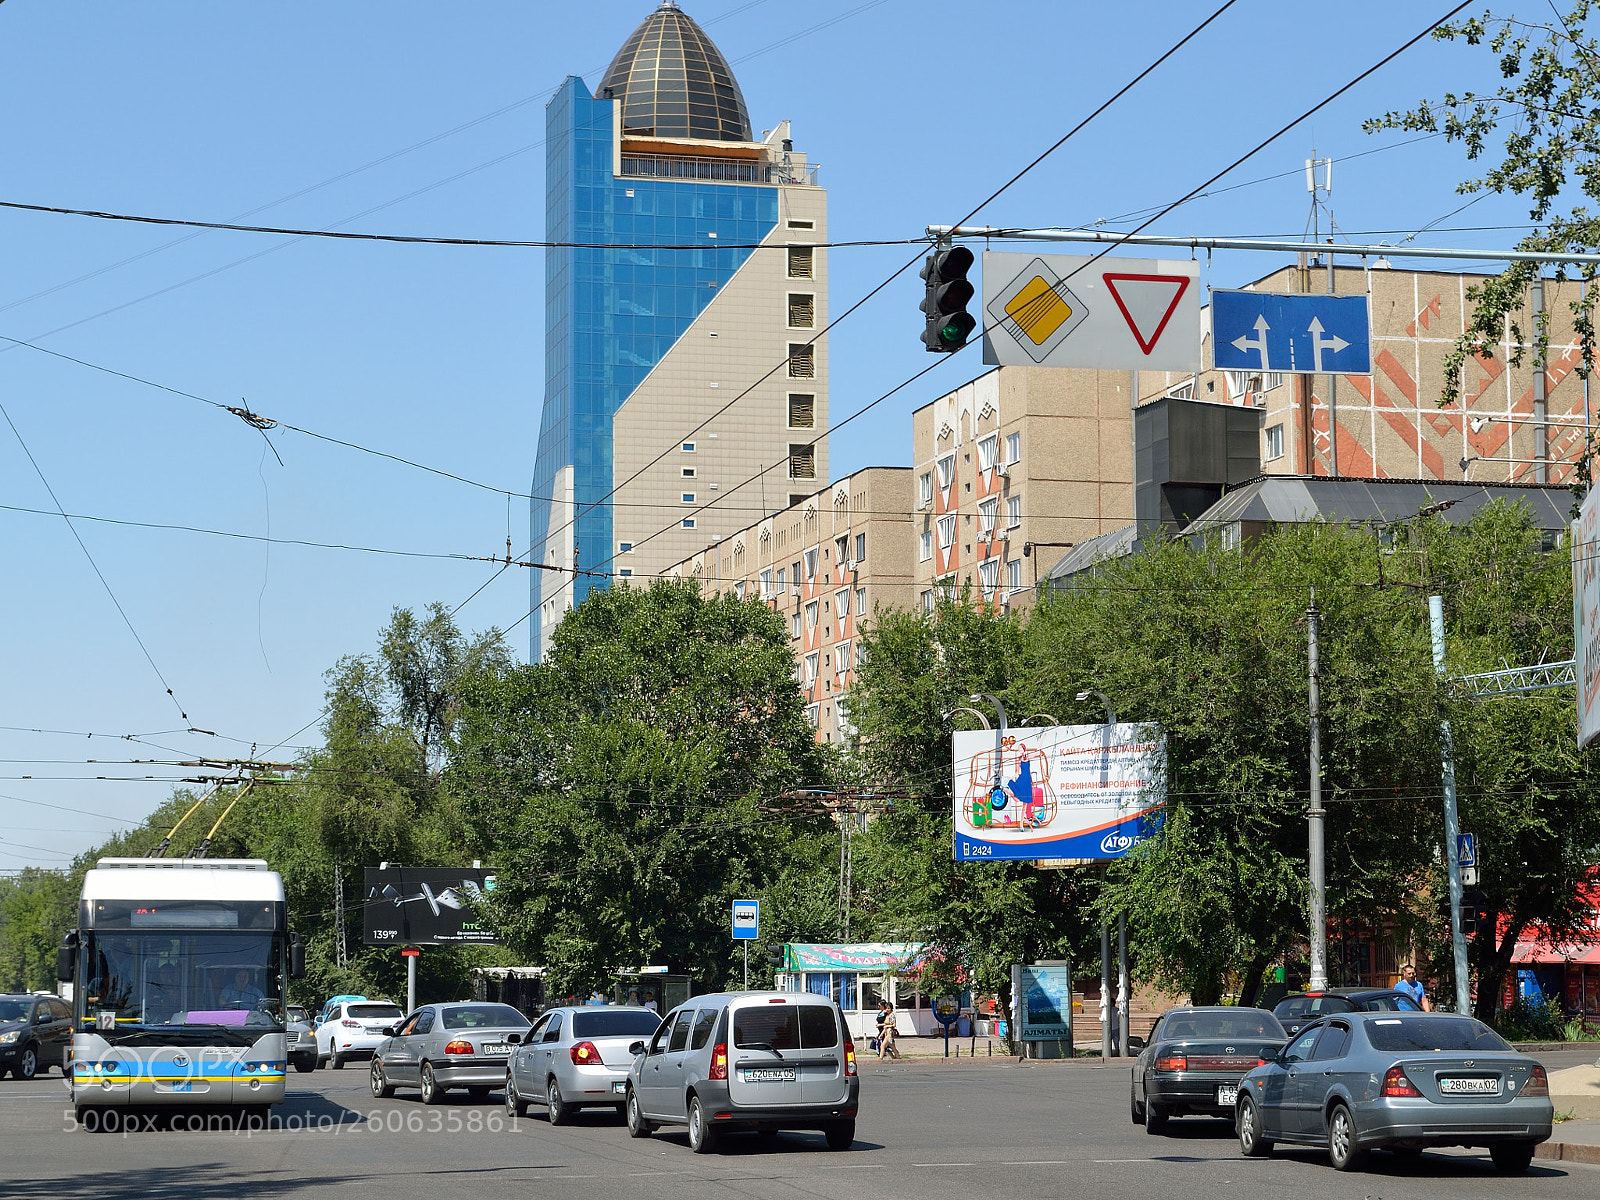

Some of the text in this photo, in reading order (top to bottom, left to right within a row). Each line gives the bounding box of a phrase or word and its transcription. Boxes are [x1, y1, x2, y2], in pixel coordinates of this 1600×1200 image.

[1060, 780, 1147, 790] РЕФИНАНСИРОВАНИЕ
[1105, 836, 1129, 848] АТФ
[972, 846, 992, 856] 2424
[462, 921, 482, 930] htc
[99, 1015, 113, 1029] 12
